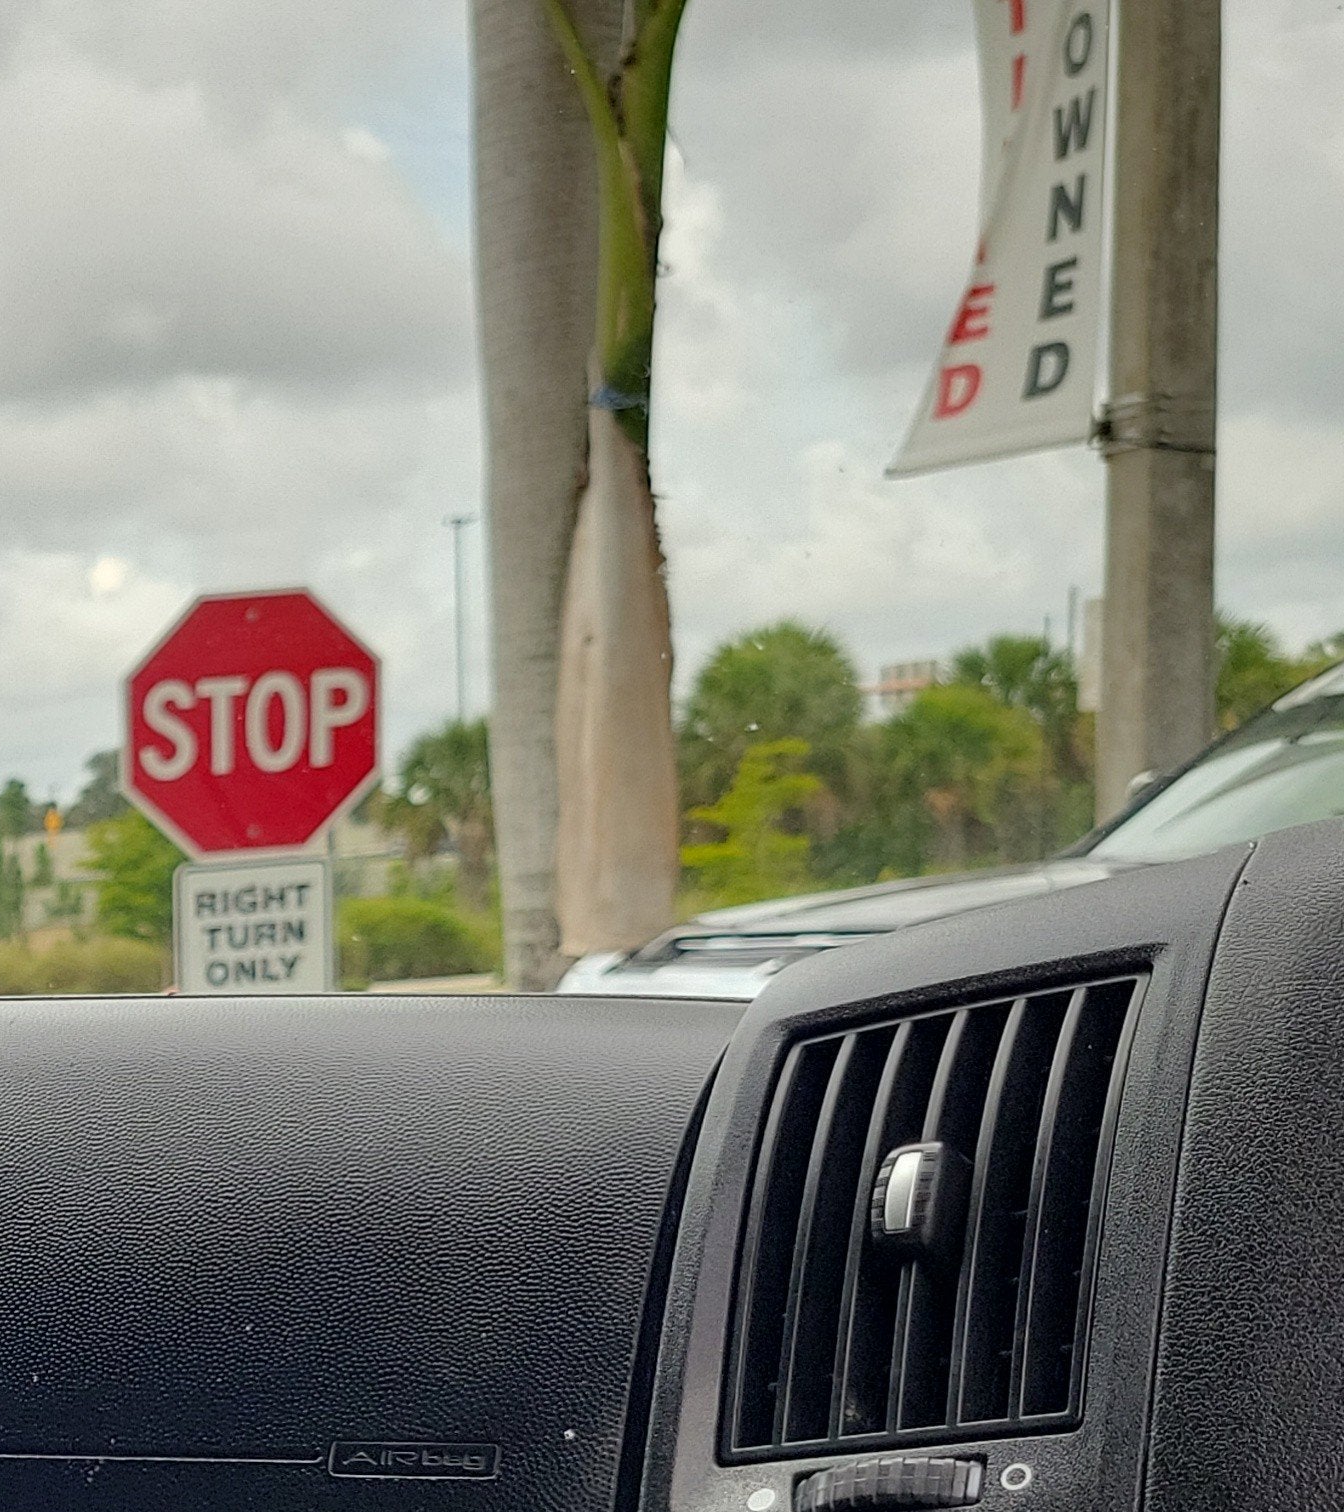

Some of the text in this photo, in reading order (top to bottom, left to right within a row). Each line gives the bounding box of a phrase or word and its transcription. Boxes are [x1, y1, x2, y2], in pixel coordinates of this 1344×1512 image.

[1020, 11, 1097, 402] OWNED
[139, 667, 372, 782] STOP
[195, 883, 312, 918] RIGHT
[204, 920, 306, 951] TURN
[205, 954, 302, 988] ONLY
